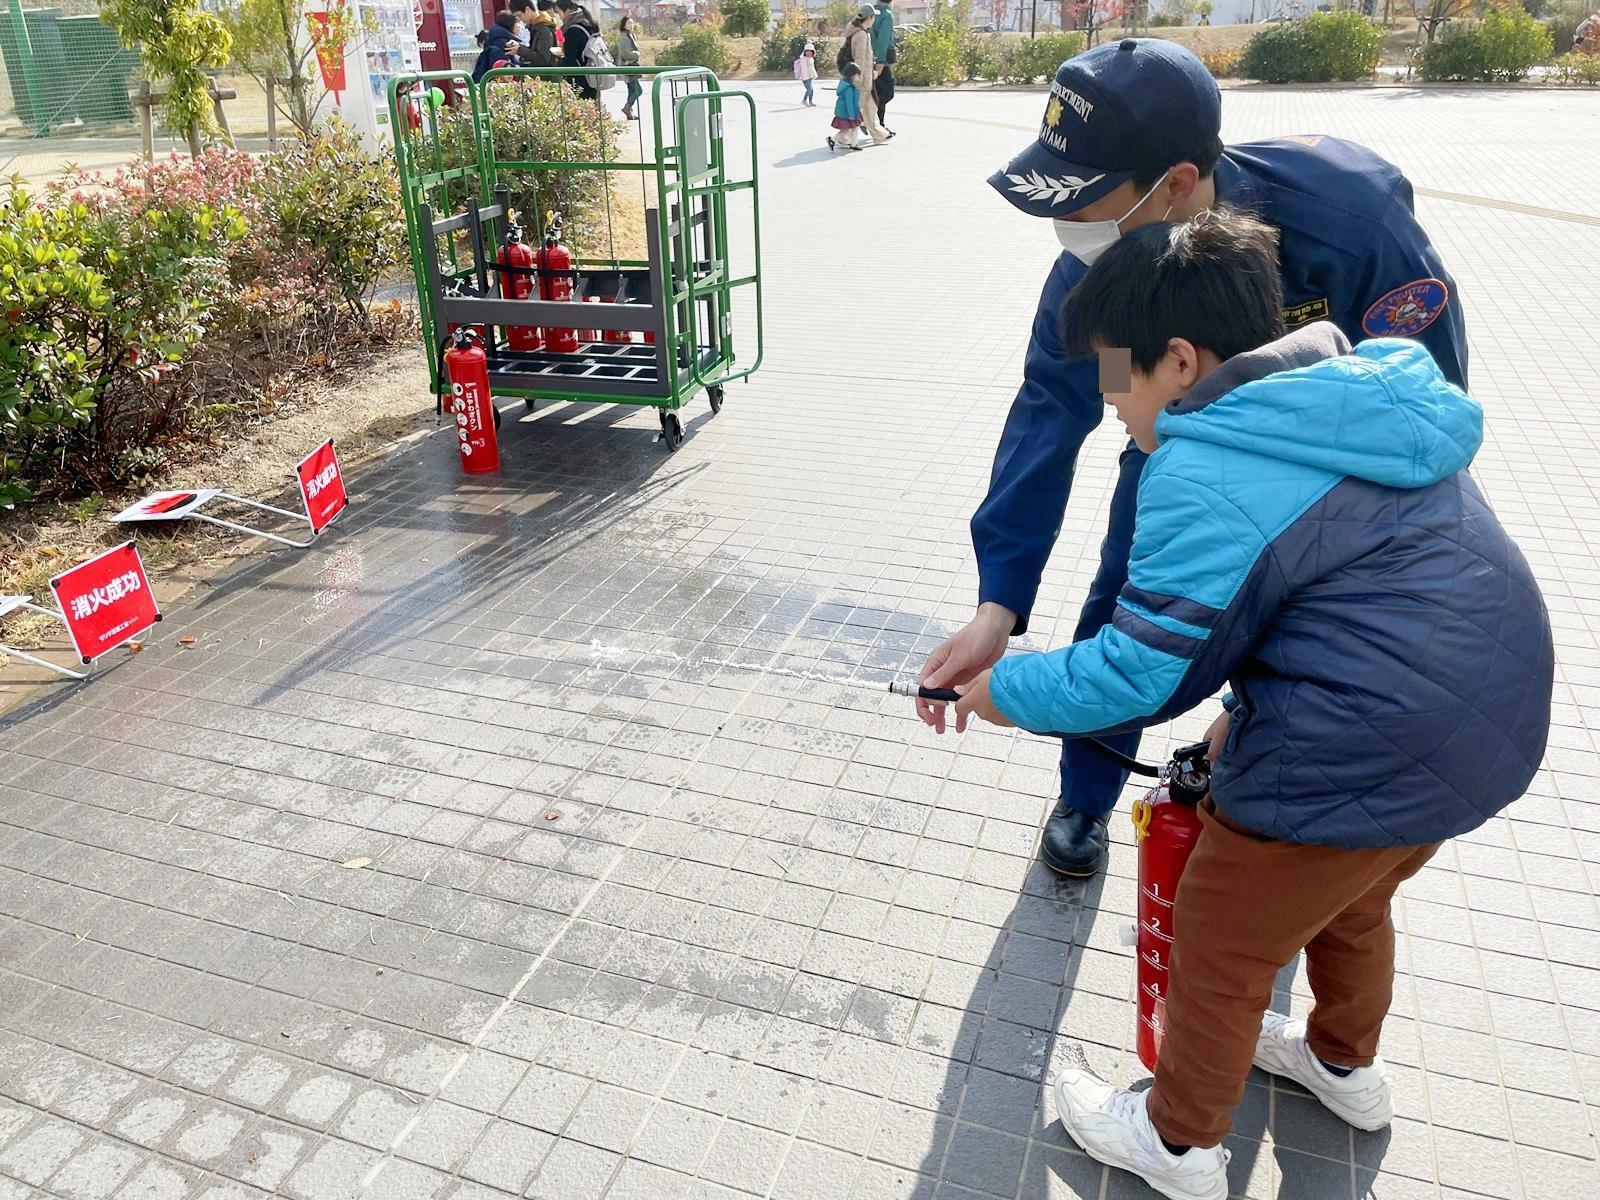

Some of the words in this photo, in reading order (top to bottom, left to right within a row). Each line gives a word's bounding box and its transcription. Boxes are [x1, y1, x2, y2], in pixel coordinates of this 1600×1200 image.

[305, 461, 338, 500] 消火成功
[70, 569, 142, 621] 消火成功
[1152, 882, 1160, 897] 1
[1151, 916, 1161, 932] 2
[1151, 949, 1160, 963] 3
[1150, 982, 1161, 995] 4
[1151, 1014, 1160, 1027] 5
